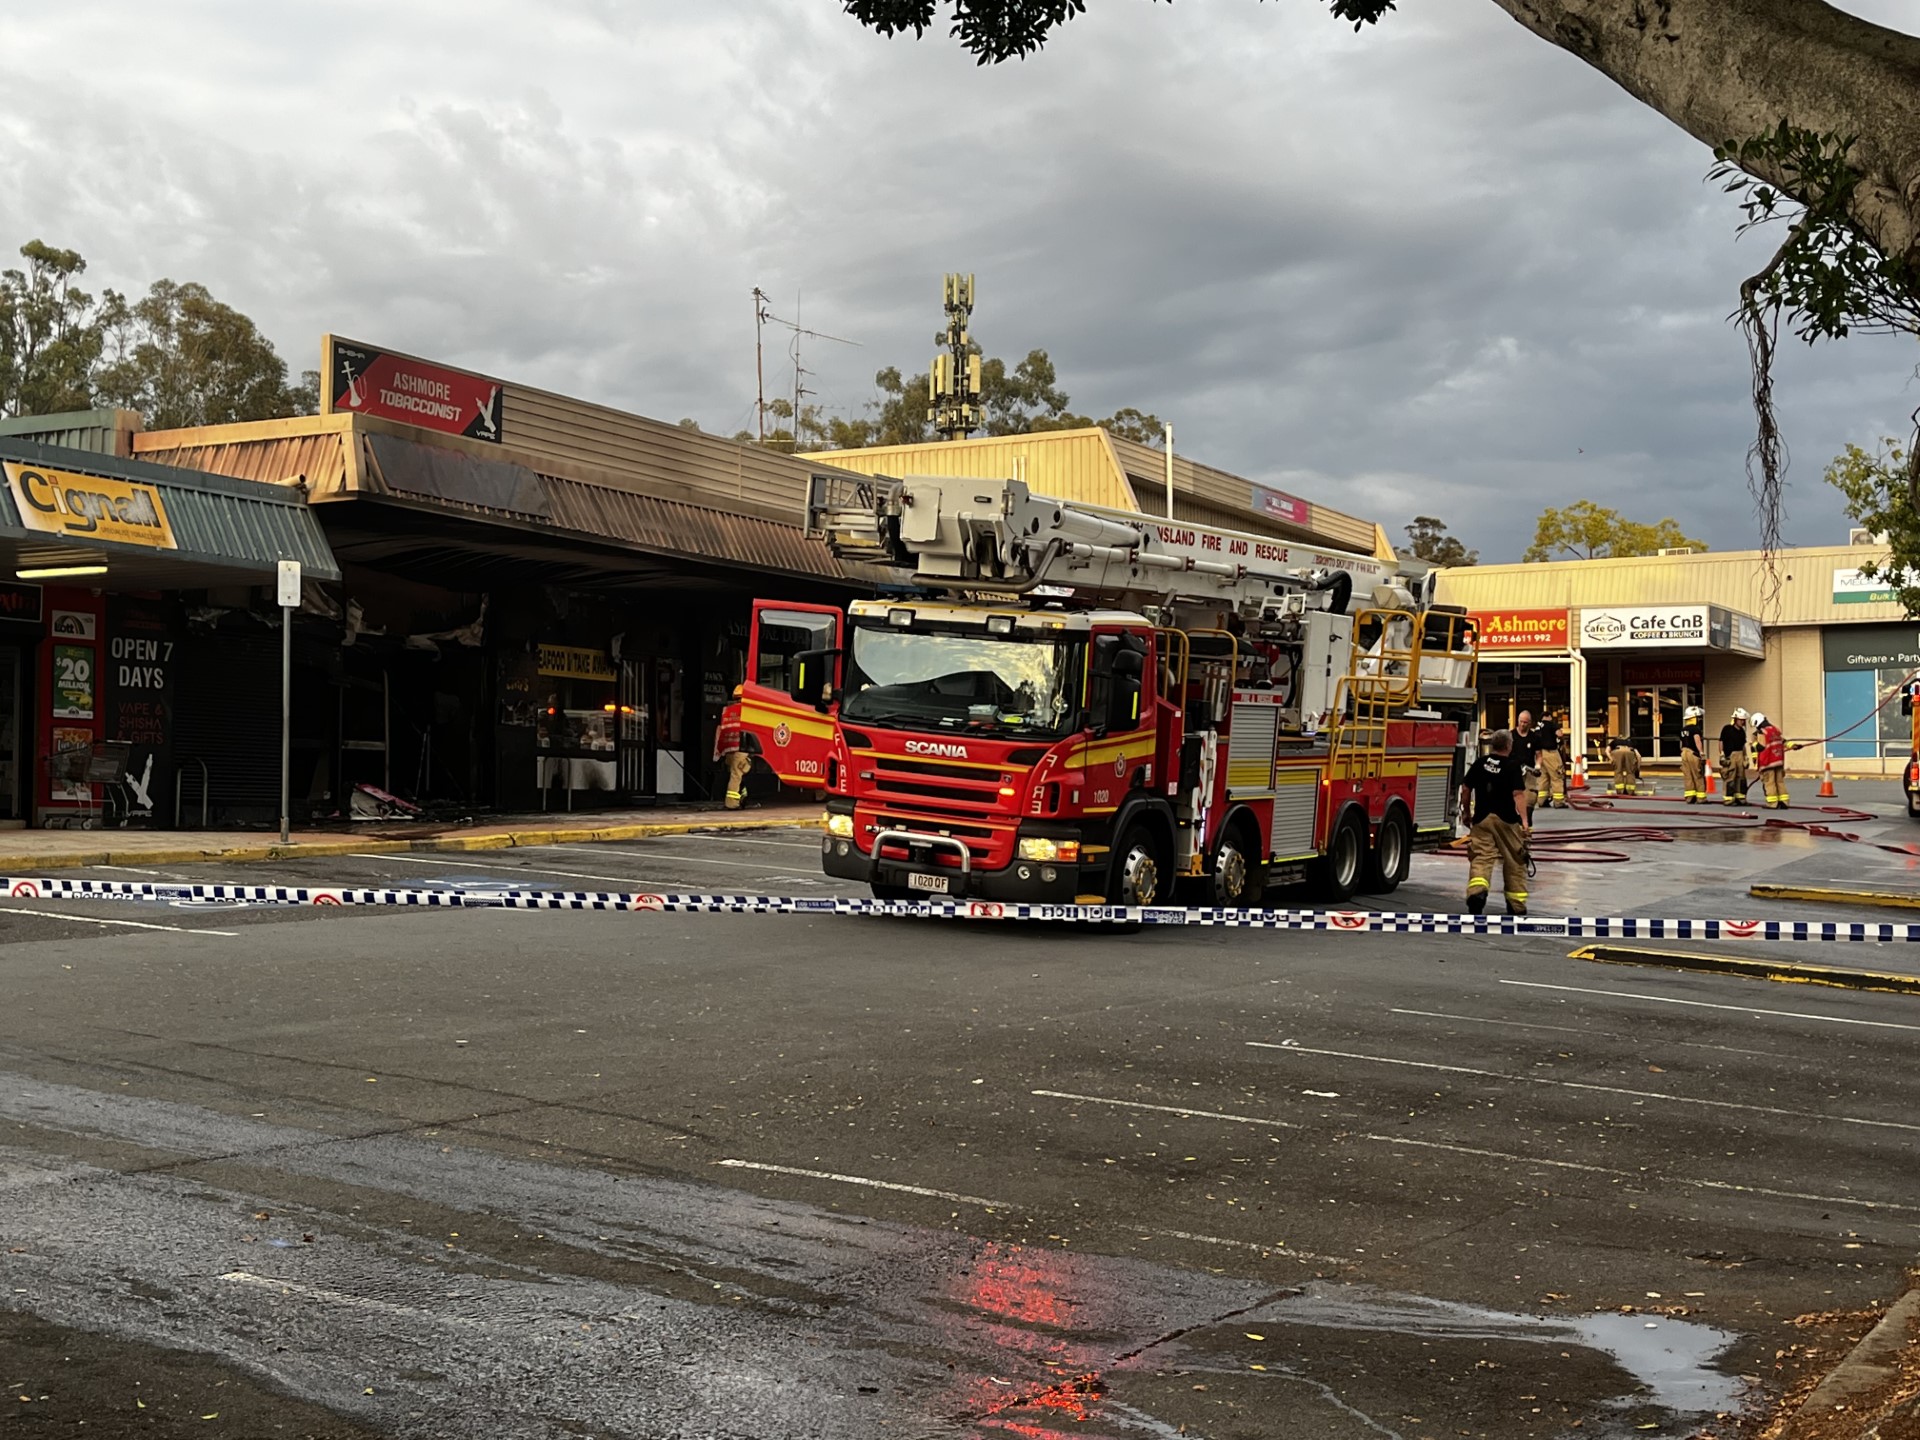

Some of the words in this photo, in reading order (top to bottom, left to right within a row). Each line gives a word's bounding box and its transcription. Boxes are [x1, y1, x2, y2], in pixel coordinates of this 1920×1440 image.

[394, 372, 451, 400] ASHMORE
[380, 389, 462, 422] TOBACCONIST
[20, 471, 162, 532] Cignall
[1201, 534, 1222, 551] FIRE
[1229, 540, 1248, 556] AND
[1255, 543, 1289, 563] RESCUE
[1869, 592, 1890, 601] Bulk
[1486, 615, 1566, 633] Ashmore
[1584, 624, 1605, 633] Cafe
[1607, 623, 1626, 633] CnB
[1630, 615, 1666, 630] Cafe
[1670, 614, 1704, 629] CnB
[1534, 633, 1551, 642] 992
[1633, 631, 1661, 639] COFFEE
[1668, 630, 1700, 639] BRUNCH
[111, 637, 158, 661] OPEN
[163, 642, 174, 662] 7
[1847, 654, 1888, 664] Giftware
[56, 657, 90, 682] $20
[1651, 668, 1701, 680] Ashmore
[119, 665, 164, 690] DAYS
[58, 680, 90, 692] MILLION
[118, 702, 150, 715] VAPE
[119, 716, 163, 729] SHISHA
[905, 740, 968, 758] SCANIA
[795, 760, 818, 773] 1020
[834, 733, 847, 793] FIRE
[1093, 789, 1110, 803] 1020
[914, 874, 934, 888] 1020
[934, 877, 947, 889] QF
